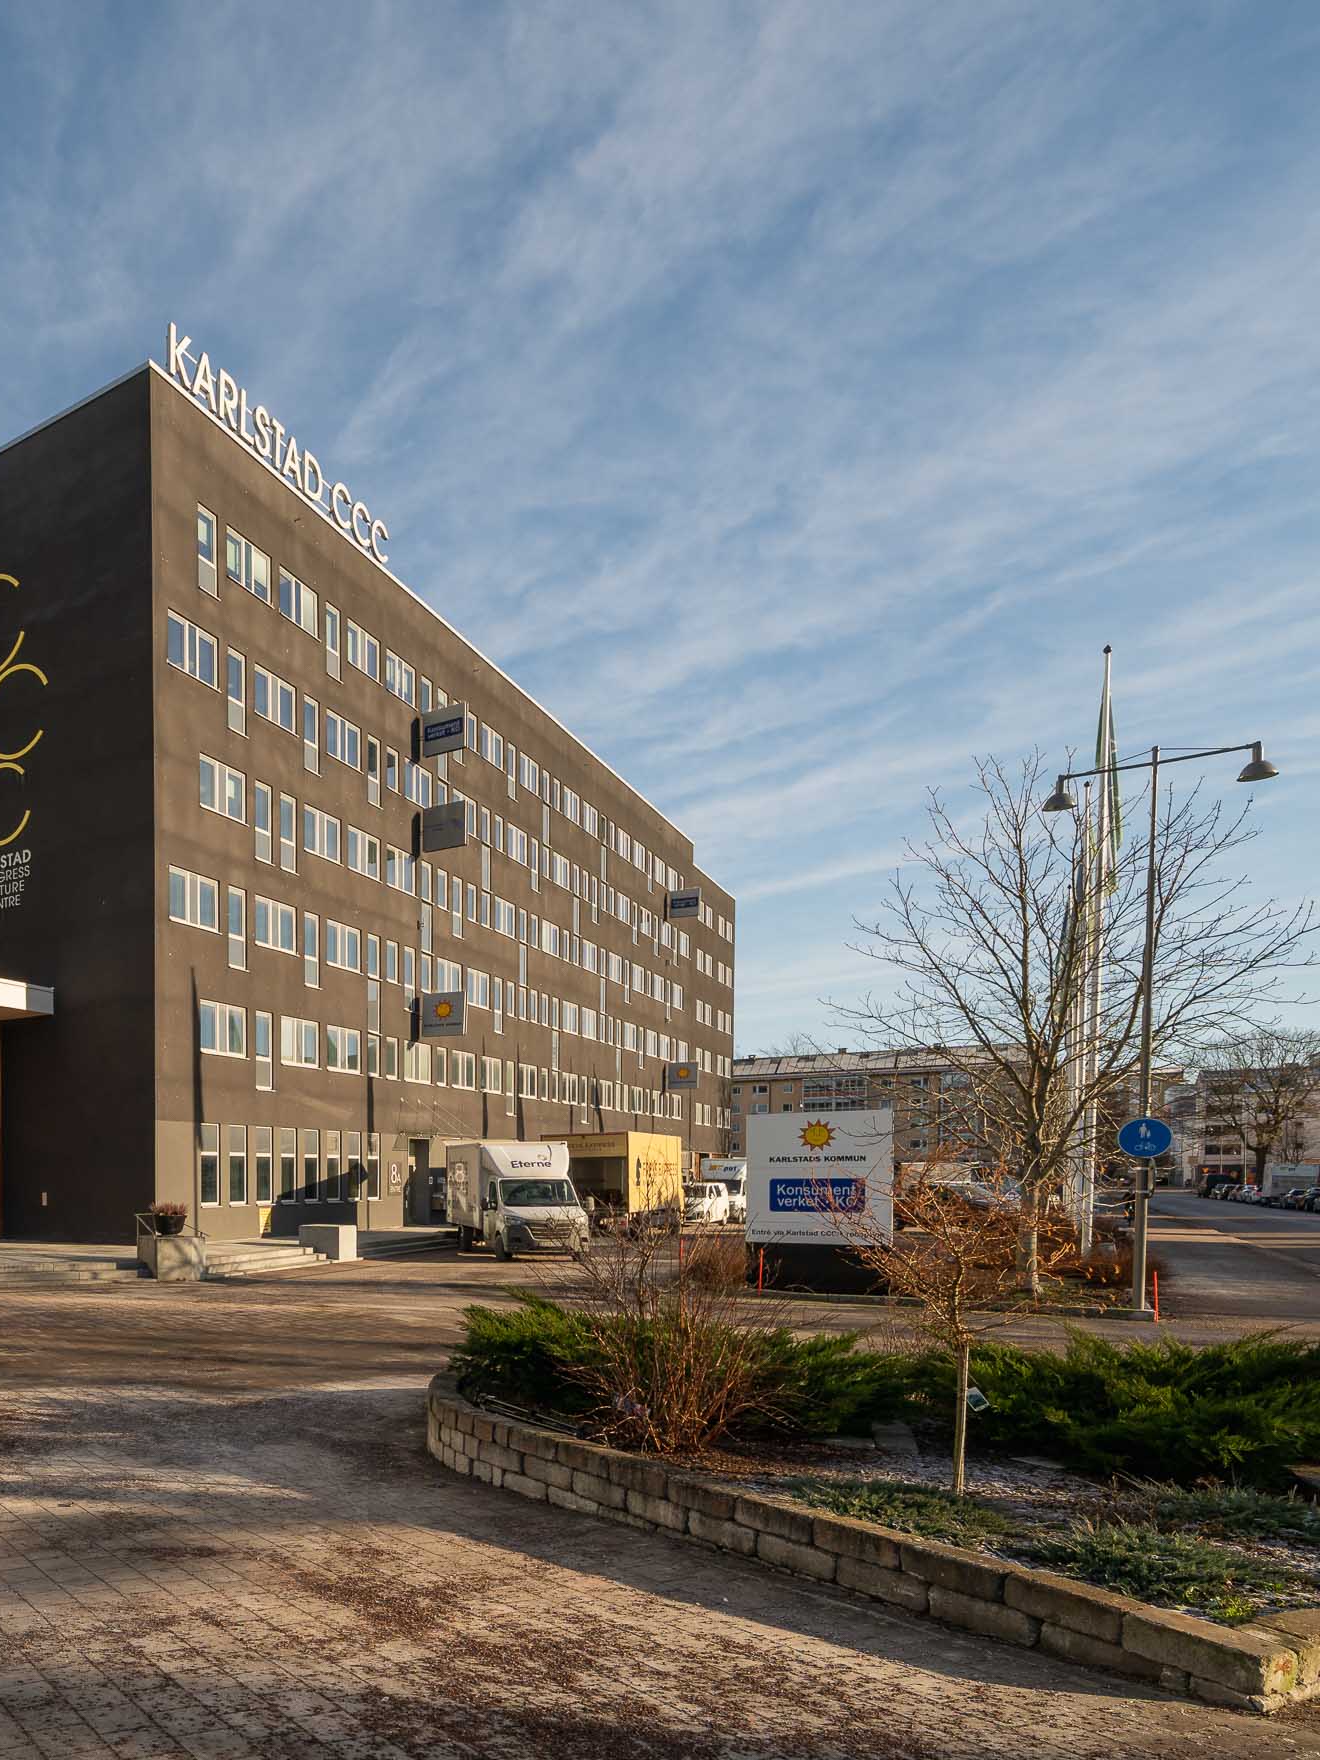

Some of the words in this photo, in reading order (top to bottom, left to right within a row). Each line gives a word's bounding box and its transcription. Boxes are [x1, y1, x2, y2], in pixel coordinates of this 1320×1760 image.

[166, 321, 324, 502] KARLSTAD
[331, 481, 390, 565] CCC
[769, 1155, 821, 1163] KARLSTADS
[786, 1229, 818, 1237] Karlstad
